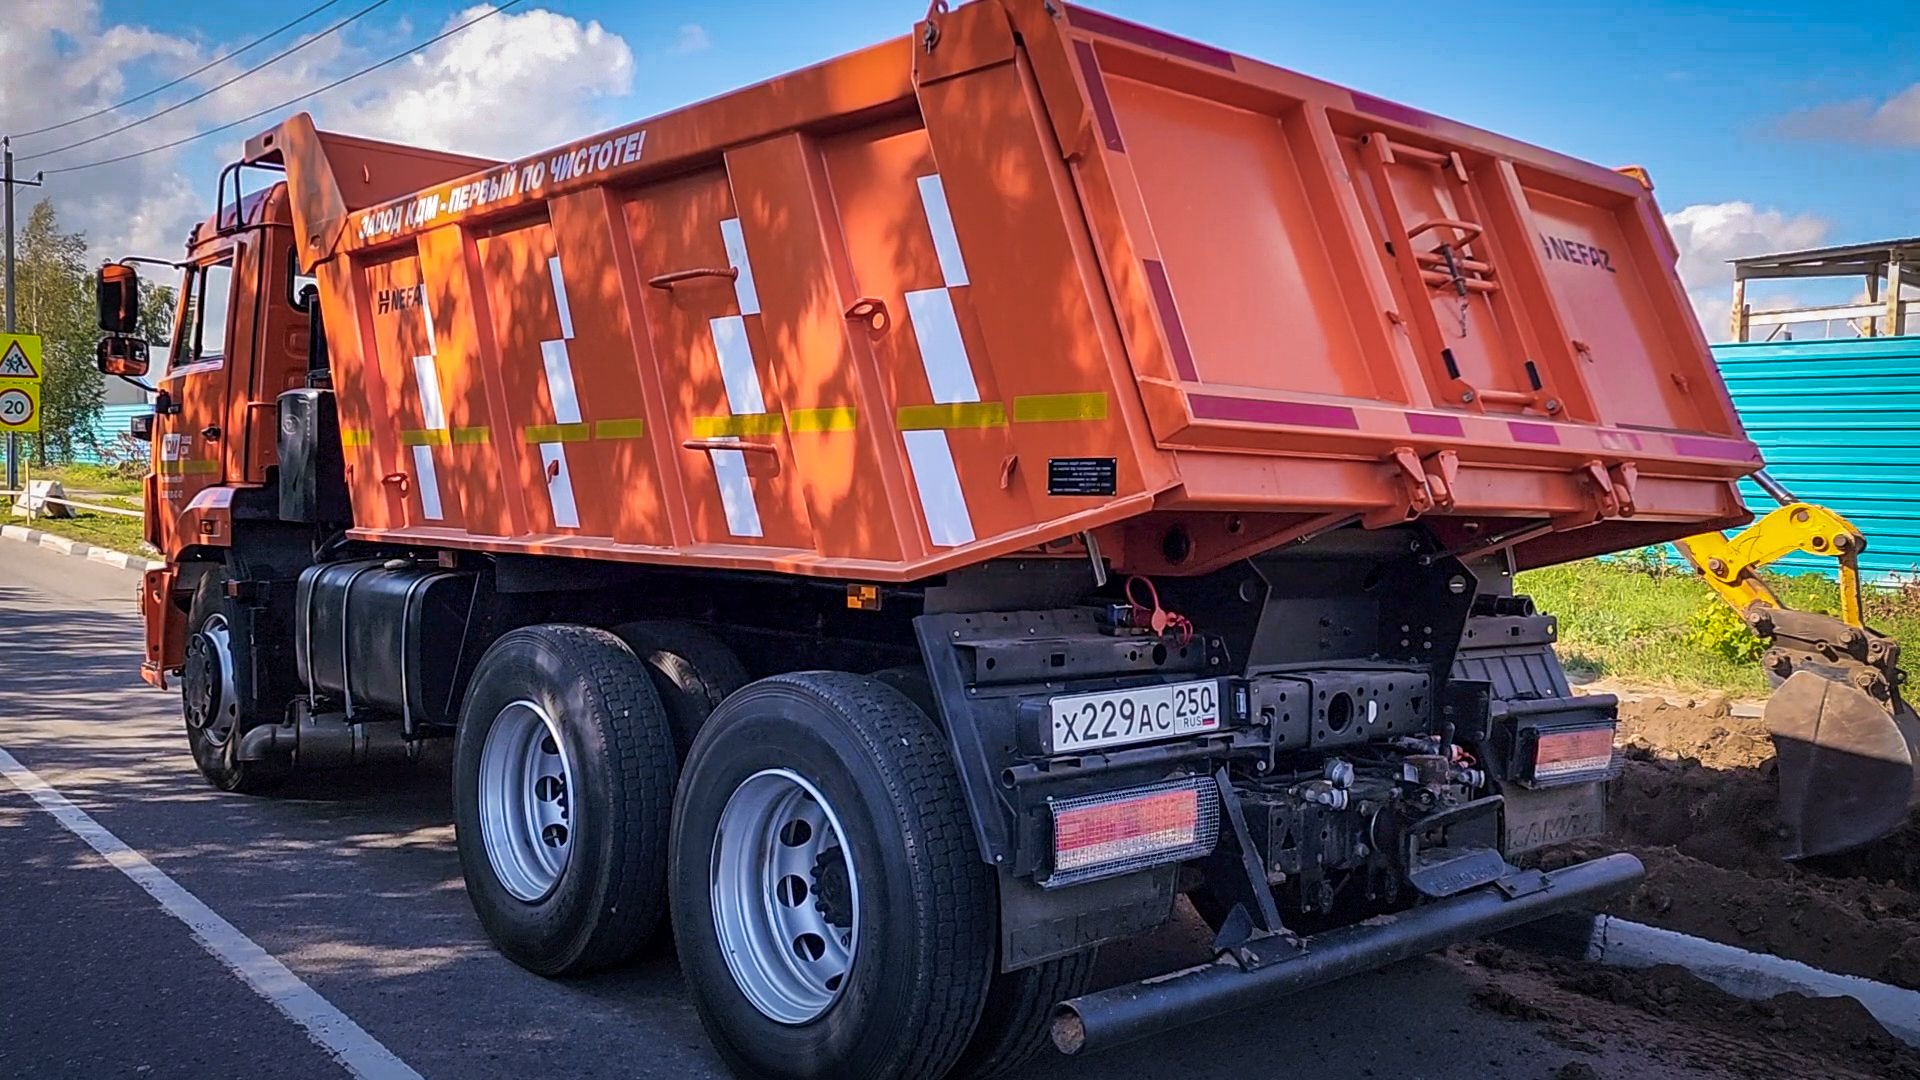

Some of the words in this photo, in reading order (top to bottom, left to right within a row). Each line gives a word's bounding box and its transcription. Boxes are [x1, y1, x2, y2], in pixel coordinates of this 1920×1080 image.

[358, 206, 403, 240] ЗАВОД
[448, 163, 517, 215] ПЕРВЫЙ
[519, 162, 546, 194] ПО
[550, 130, 647, 183] ЧИСТОТЕ!
[391, 284, 423, 312] NEFA
[4, 400, 25, 415] 20
[1175, 686, 1213, 718] 250
[1183, 716, 1201, 728] RUS
